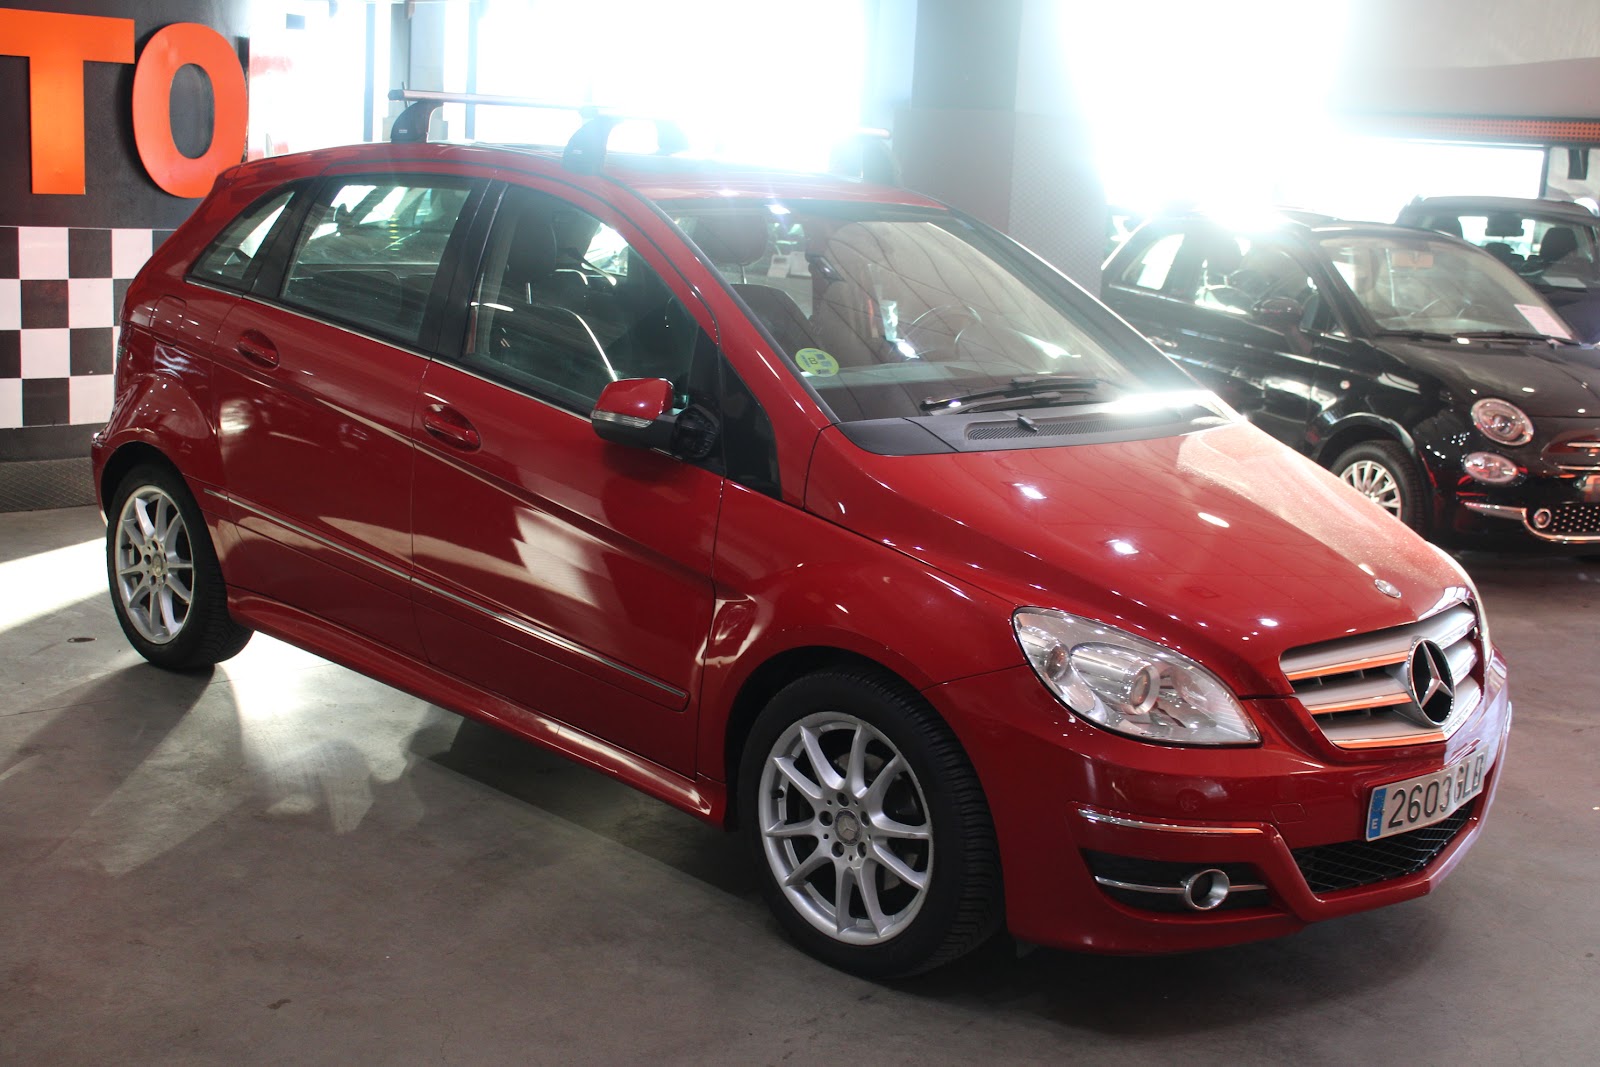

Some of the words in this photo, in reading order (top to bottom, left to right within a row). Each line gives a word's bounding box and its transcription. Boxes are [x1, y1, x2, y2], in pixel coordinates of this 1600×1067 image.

[0, 8, 248, 198] TO
[1371, 818, 1378, 829] E
[1388, 774, 1452, 828] 2603
